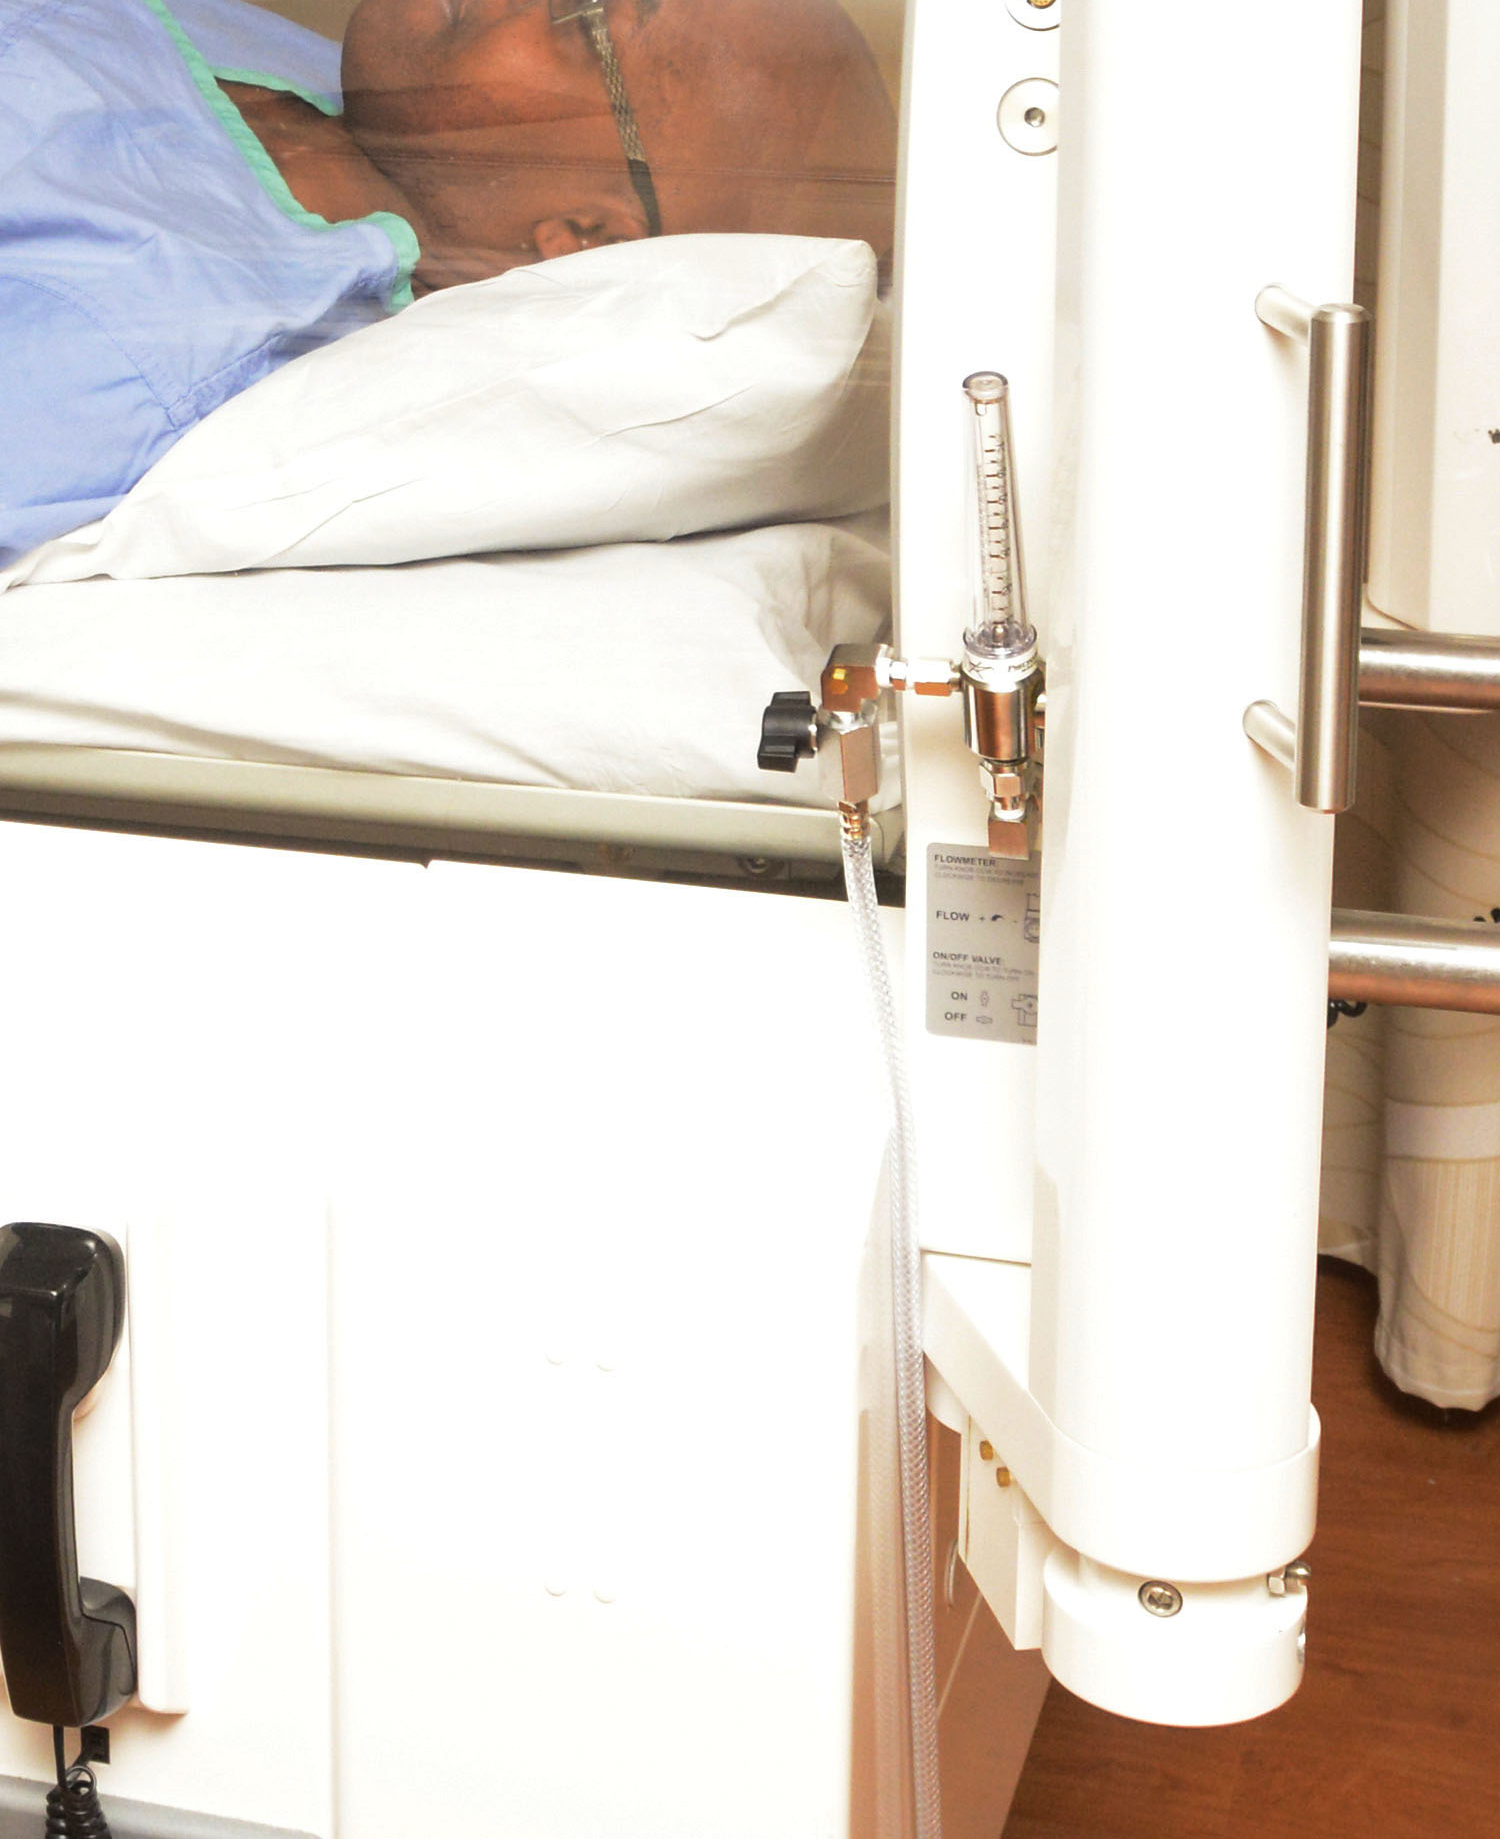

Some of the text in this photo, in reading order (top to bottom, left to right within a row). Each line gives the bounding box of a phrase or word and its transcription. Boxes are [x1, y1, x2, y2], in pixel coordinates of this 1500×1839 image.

[934, 854, 996, 866] FLOWMETER
[936, 910, 969, 922] FLOW
[933, 951, 969, 962] ON/OFF
[951, 991, 968, 1001] ON
[944, 1011, 967, 1021] OFF
